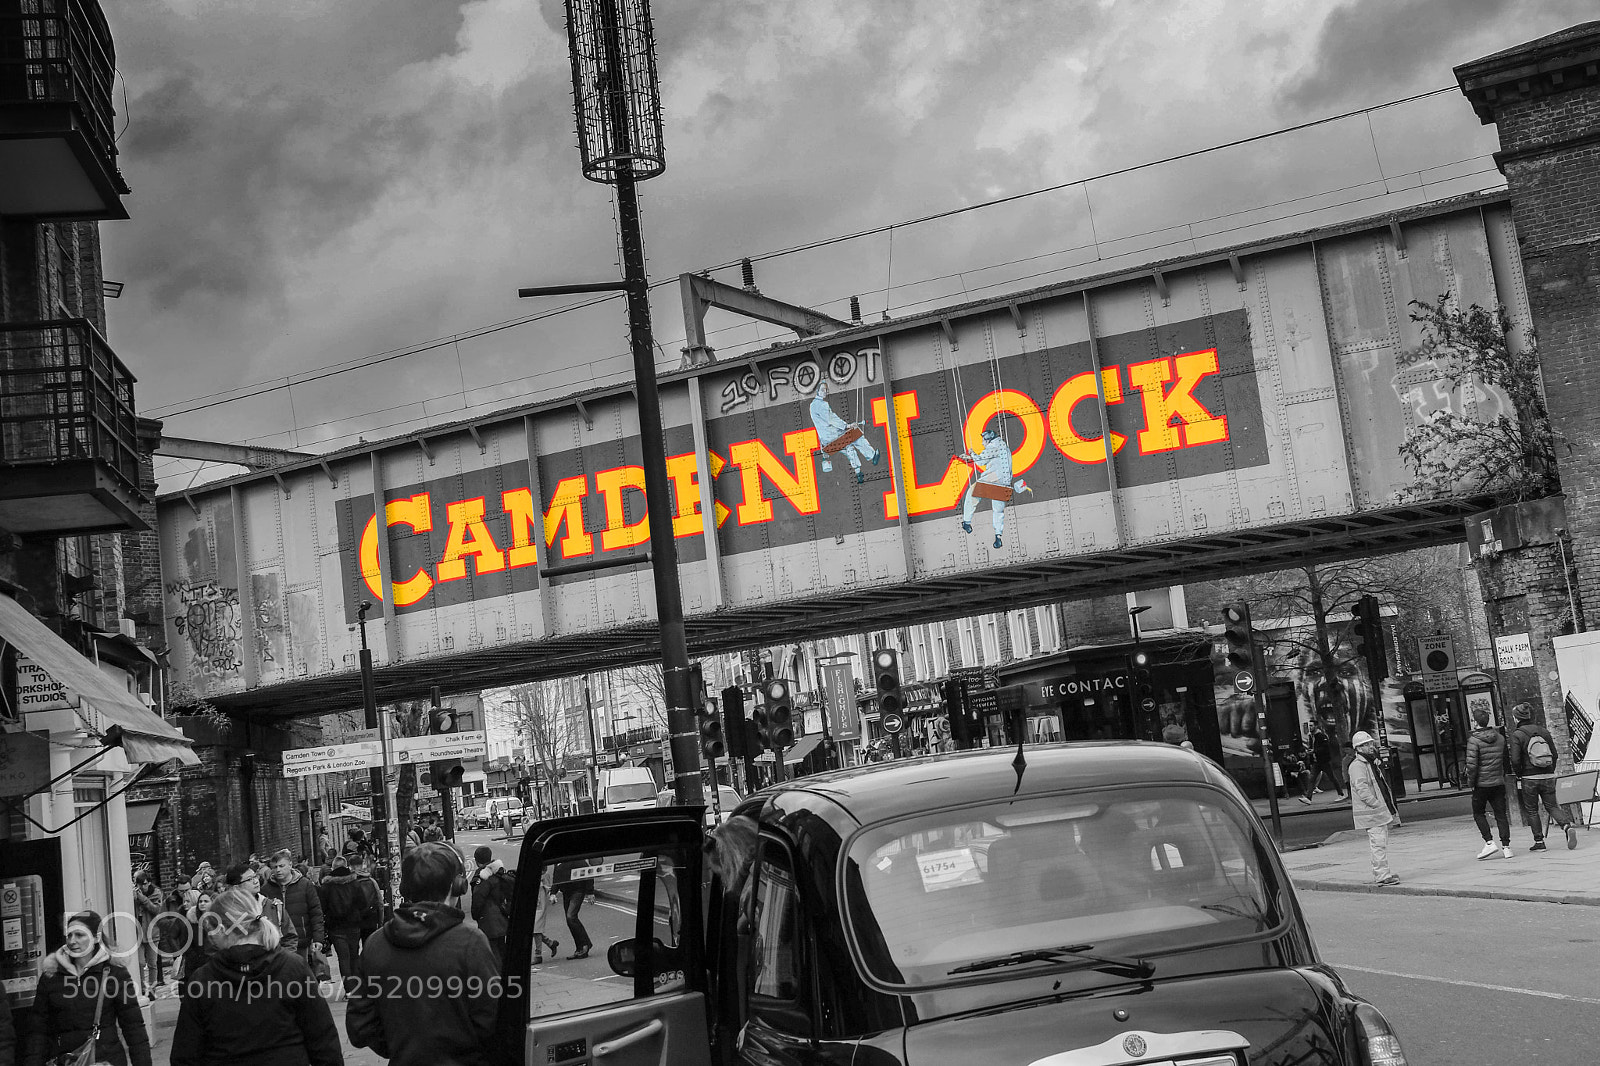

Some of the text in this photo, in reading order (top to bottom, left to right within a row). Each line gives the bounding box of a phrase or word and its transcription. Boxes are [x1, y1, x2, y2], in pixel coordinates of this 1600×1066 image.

[767, 347, 881, 401] FOOT
[359, 348, 1229, 606] CAMDEN LOCK
[31, 673, 46, 682] TO
[1041, 676, 1129, 697] EYE CONTAC
[23, 692, 66, 704] STUDIOS
[285, 752, 310, 760] Camden
[430, 749, 463, 757] Roundhouse
[286, 765, 312, 774] Regent's
[332, 760, 353, 768] London
